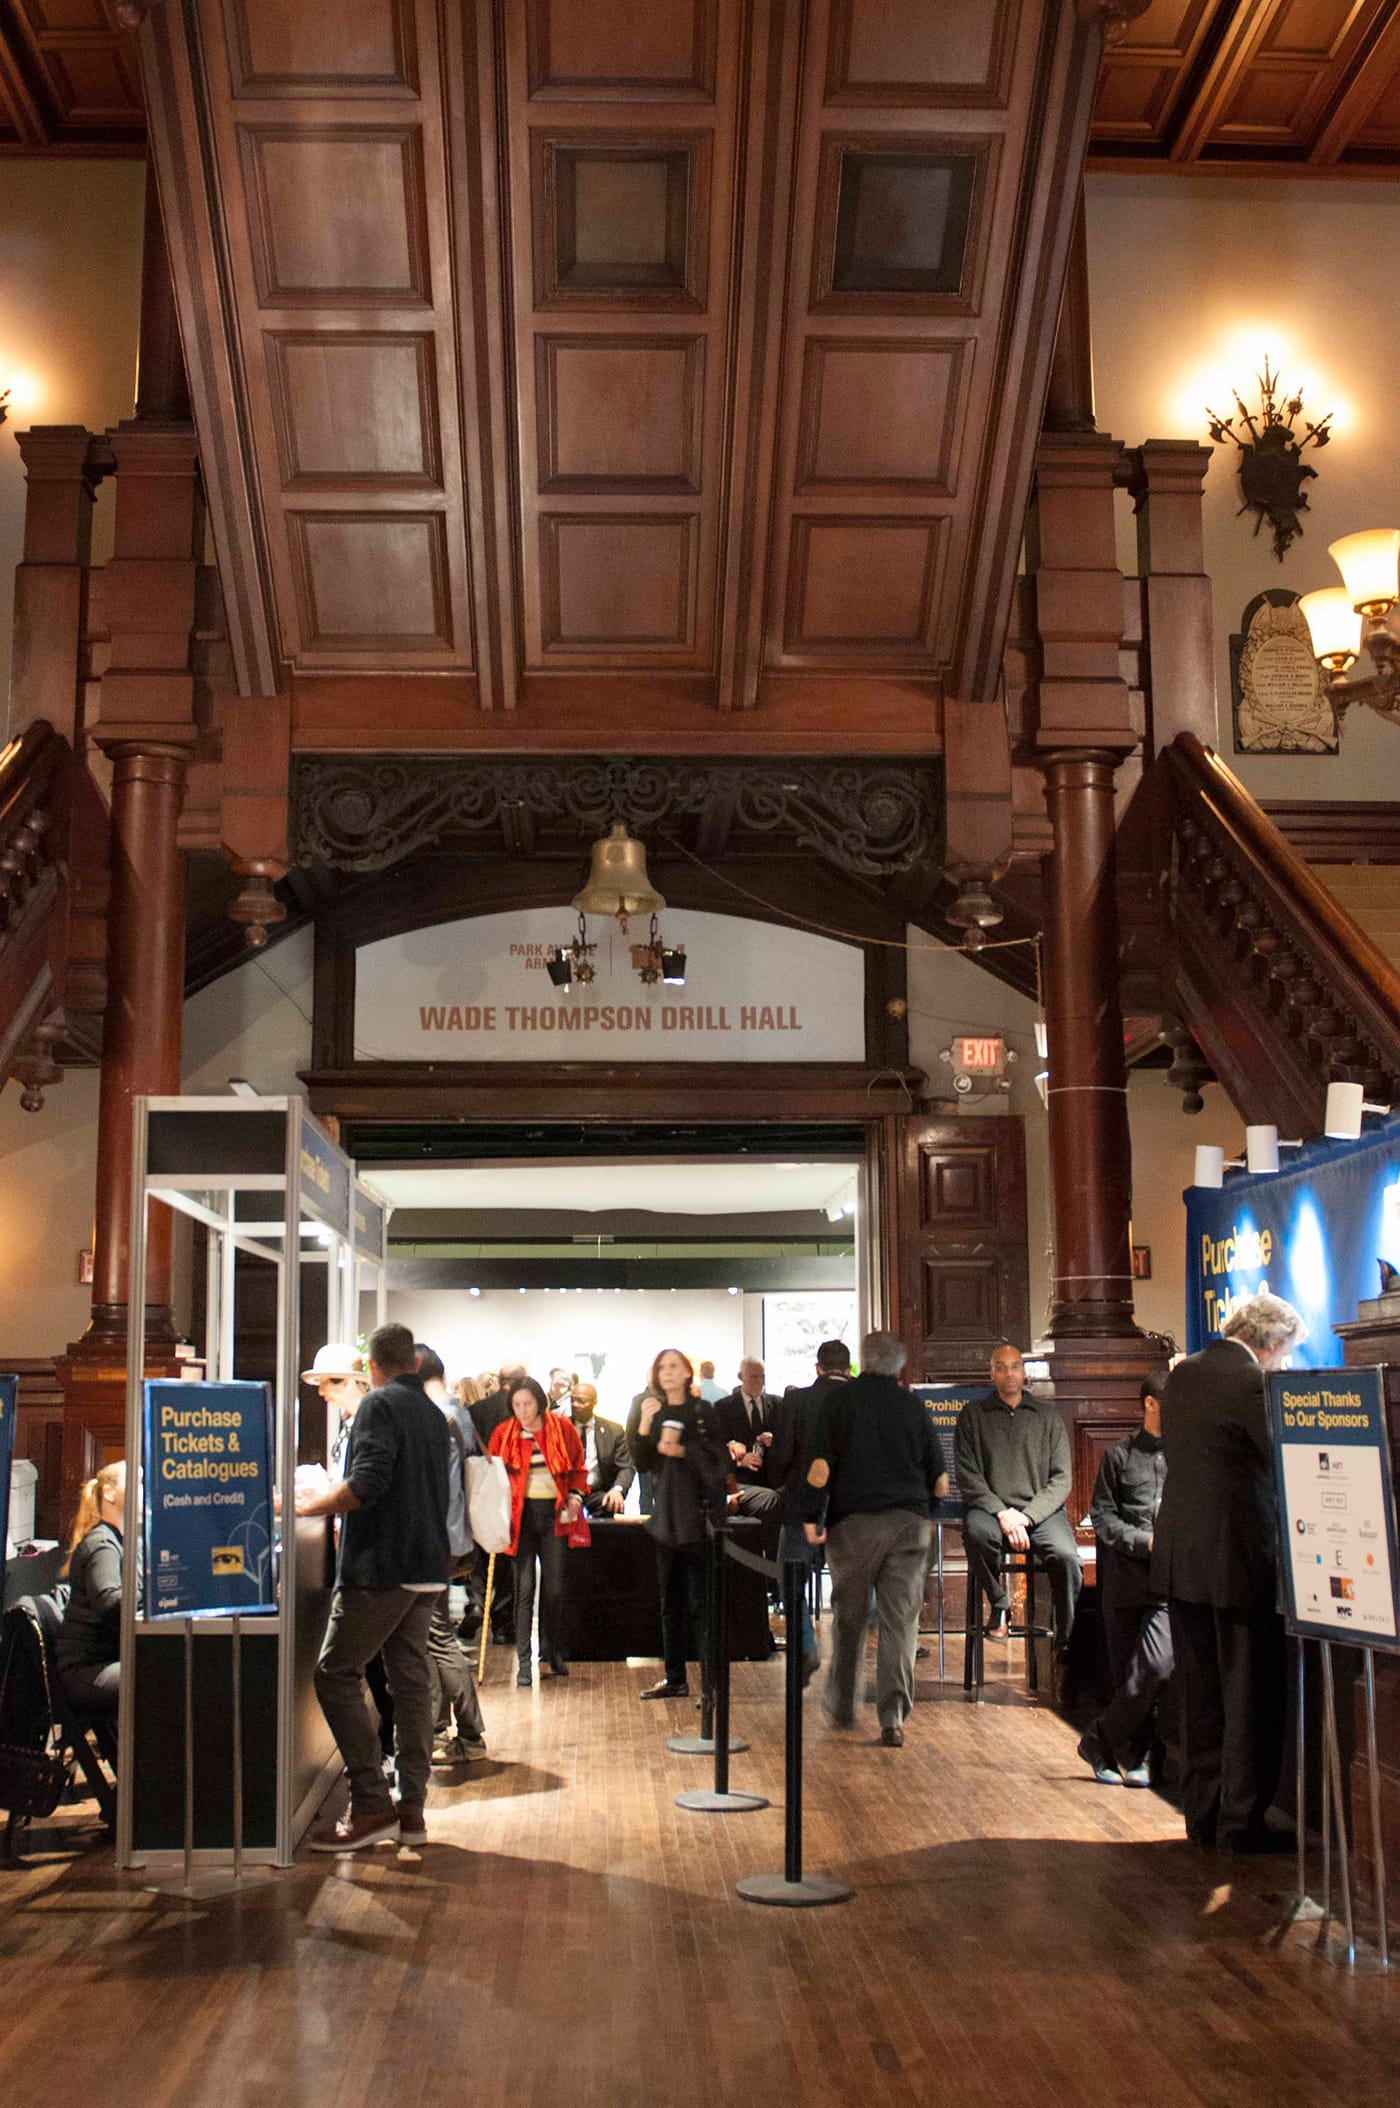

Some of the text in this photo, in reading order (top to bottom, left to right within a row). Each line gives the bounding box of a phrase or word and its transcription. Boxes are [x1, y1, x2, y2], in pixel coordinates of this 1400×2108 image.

[510, 943, 542, 956] PARK
[419, 1006, 802, 1030] WADE THOMPSON DRILL HALL
[962, 1038, 999, 1066] EXIT
[1202, 1225, 1272, 1277] Purchse
[1283, 1391, 1361, 1410] Special Thanks
[161, 1406, 242, 1427] Purchase
[1284, 1410, 1369, 1430] to Our Sponsors
[161, 1432, 241, 1453] Tickets &
[161, 1458, 258, 1482] Catalogues
[163, 1492, 245, 1509] (Cash and Credit)
[1336, 1606, 1353, 1617] NYC
